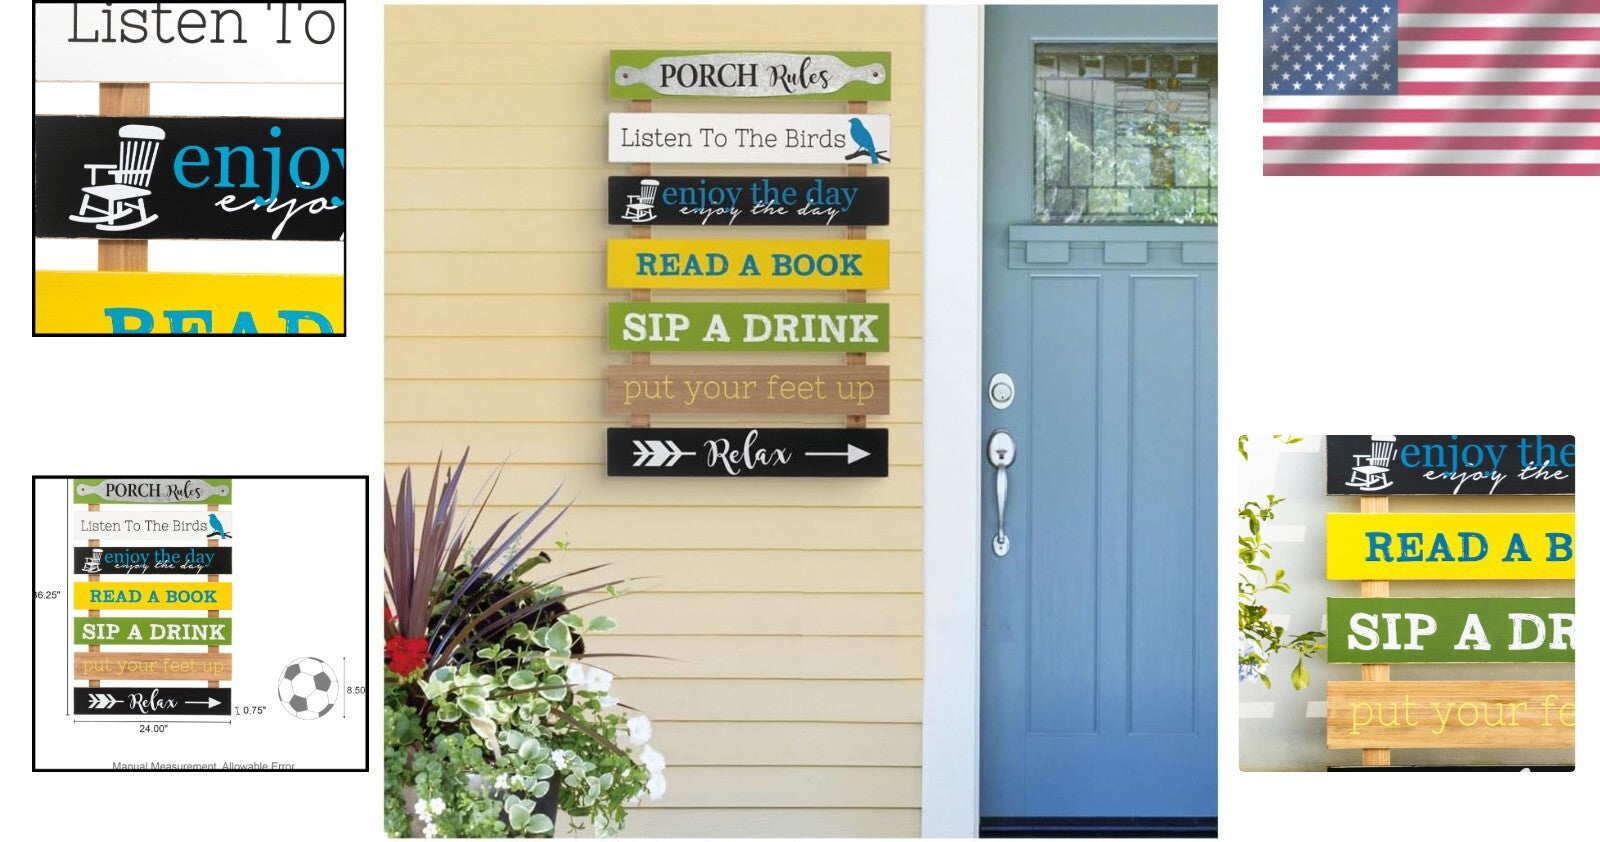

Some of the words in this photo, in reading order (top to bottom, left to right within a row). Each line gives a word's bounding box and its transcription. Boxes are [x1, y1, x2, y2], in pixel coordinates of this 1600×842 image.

[68, 3, 248, 44] Listen
[267, 3, 335, 44] To
[660, 64, 758, 88] PORCH
[767, 56, 833, 93] Rules
[622, 128, 692, 148] Listen
[700, 129, 728, 148] To
[735, 129, 777, 148] The
[785, 129, 846, 148] Birds
[662, 179, 742, 213] enjoy
[750, 180, 797, 206] the
[806, 176, 859, 212] day
[215, 181, 344, 240] enjo
[679, 206, 742, 226] enjoy
[750, 199, 789, 216] the
[798, 199, 840, 225] day
[636, 253, 729, 276] READ
[738, 254, 761, 276] A
[772, 254, 862, 276] BOOK
[622, 312, 690, 342] SIP
[702, 316, 730, 342] A
[743, 314, 878, 343] DRINK
[623, 375, 676, 404] put
[684, 379, 757, 406] your
[767, 374, 827, 399] feet
[836, 378, 874, 406] up
[703, 430, 792, 475] Relax
[1401, 435, 1507, 478] enjoy
[1518, 435, 1575, 467] the
[106, 484, 161, 498] PORCH
[166, 480, 203, 500] Rules
[1423, 463, 1508, 494] enjoy
[1517, 460, 1568, 480] the
[81, 520, 121, 532] Listen
[125, 520, 141, 532] To
[145, 521, 169, 532] The
[173, 520, 208, 532] Birds
[104, 550, 150, 567] enjoy
[153, 548, 181, 564] the
[185, 548, 215, 566] day
[1365, 532, 1488, 563] READ
[1502, 533, 1532, 562] A
[154, 559, 176, 570] the
[180, 559, 206, 574] day
[90, 589, 143, 603] READ
[148, 590, 160, 603] A
[165, 589, 217, 603] BOOK
[82, 624, 120, 640] SIP
[127, 624, 143, 640] A
[150, 624, 226, 641] DRINK
[1348, 612, 1438, 651] SIP
[1454, 613, 1492, 651] A
[82, 658, 112, 676] put
[116, 660, 158, 676] your
[163, 657, 198, 673] feet
[201, 660, 224, 676] up
[128, 688, 178, 713] Relax
[243, 706, 266, 714] 0.75"
[1349, 694, 1418, 735] put
[1431, 700, 1528, 735] your
[140, 724, 168, 733] 24.00"
[112, 762, 148, 770] Manual
